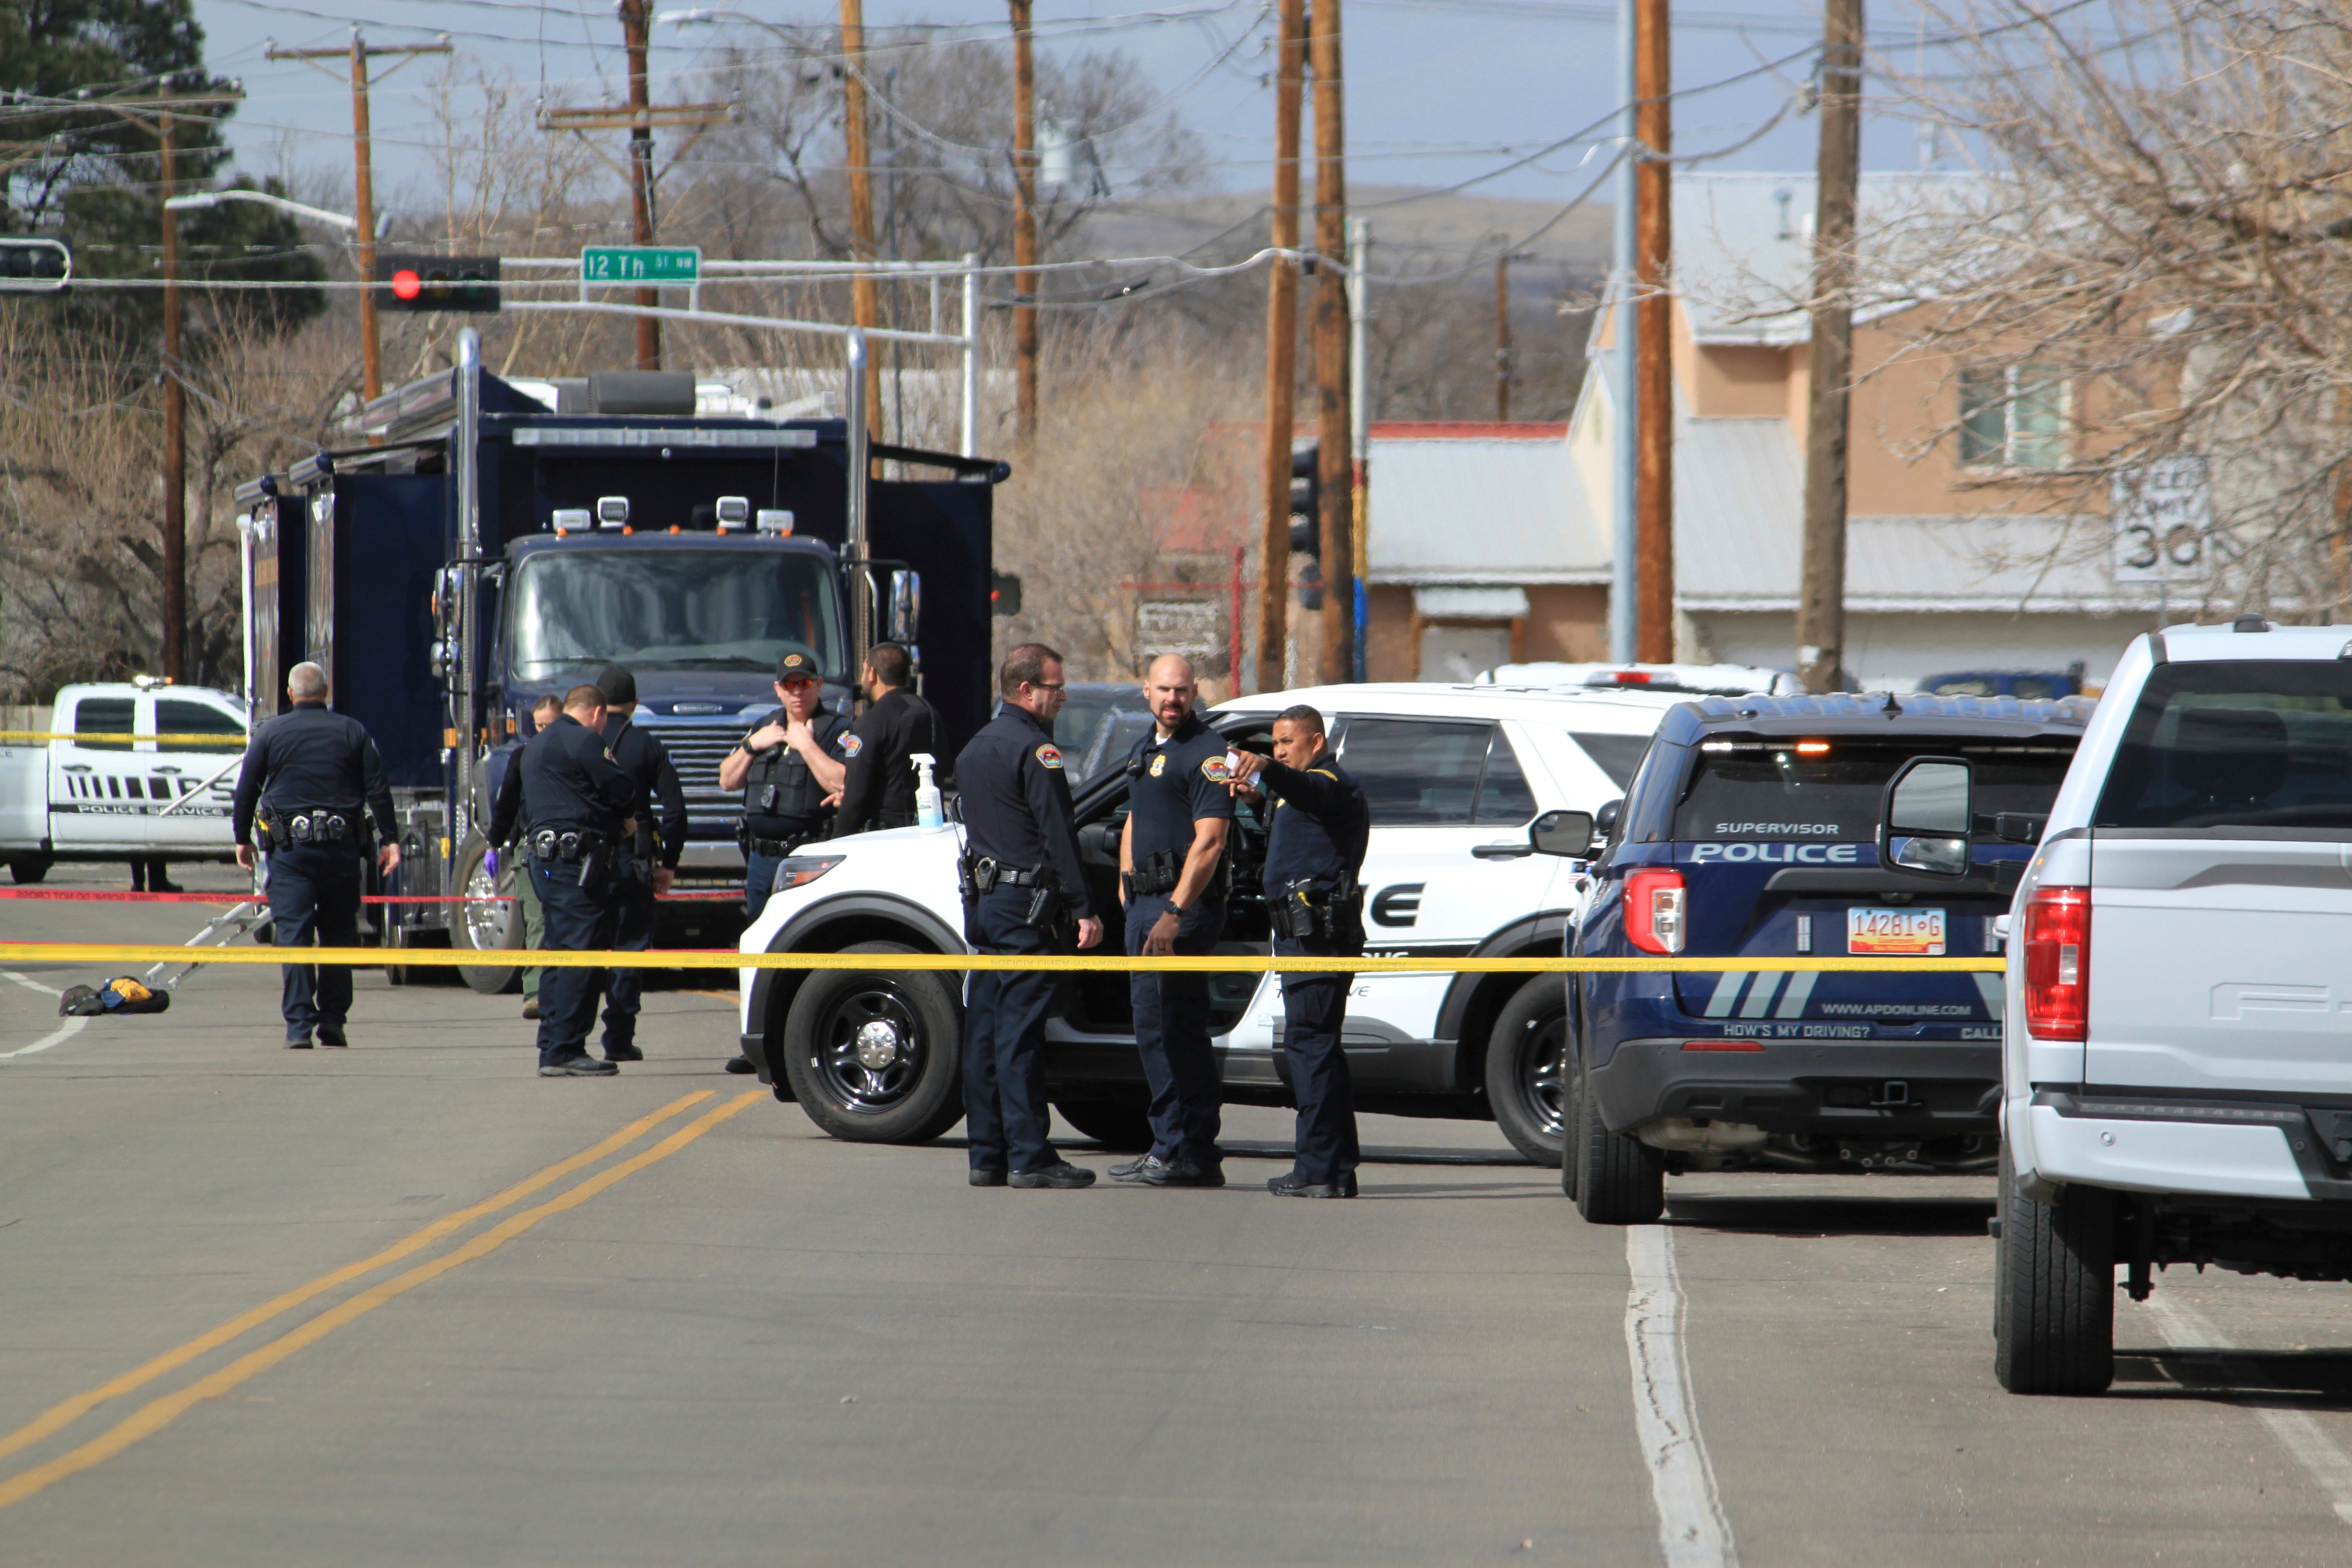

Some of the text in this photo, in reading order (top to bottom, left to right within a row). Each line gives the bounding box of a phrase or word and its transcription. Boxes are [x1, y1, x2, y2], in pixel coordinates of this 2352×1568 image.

[676, 257, 692, 269] NW
[2127, 524, 2200, 568] 30
[78, 805, 140, 814] POLICE
[1715, 823, 1839, 834] SUPERVISOR
[1690, 843, 1857, 862] POLICE
[1821, 1003, 1971, 1015] WWW.APDONLINE.COM
[1723, 1025, 1771, 1036] HOW'S
[1777, 1025, 1799, 1037] MY
[1804, 1026, 1870, 1037] DRIVING?
